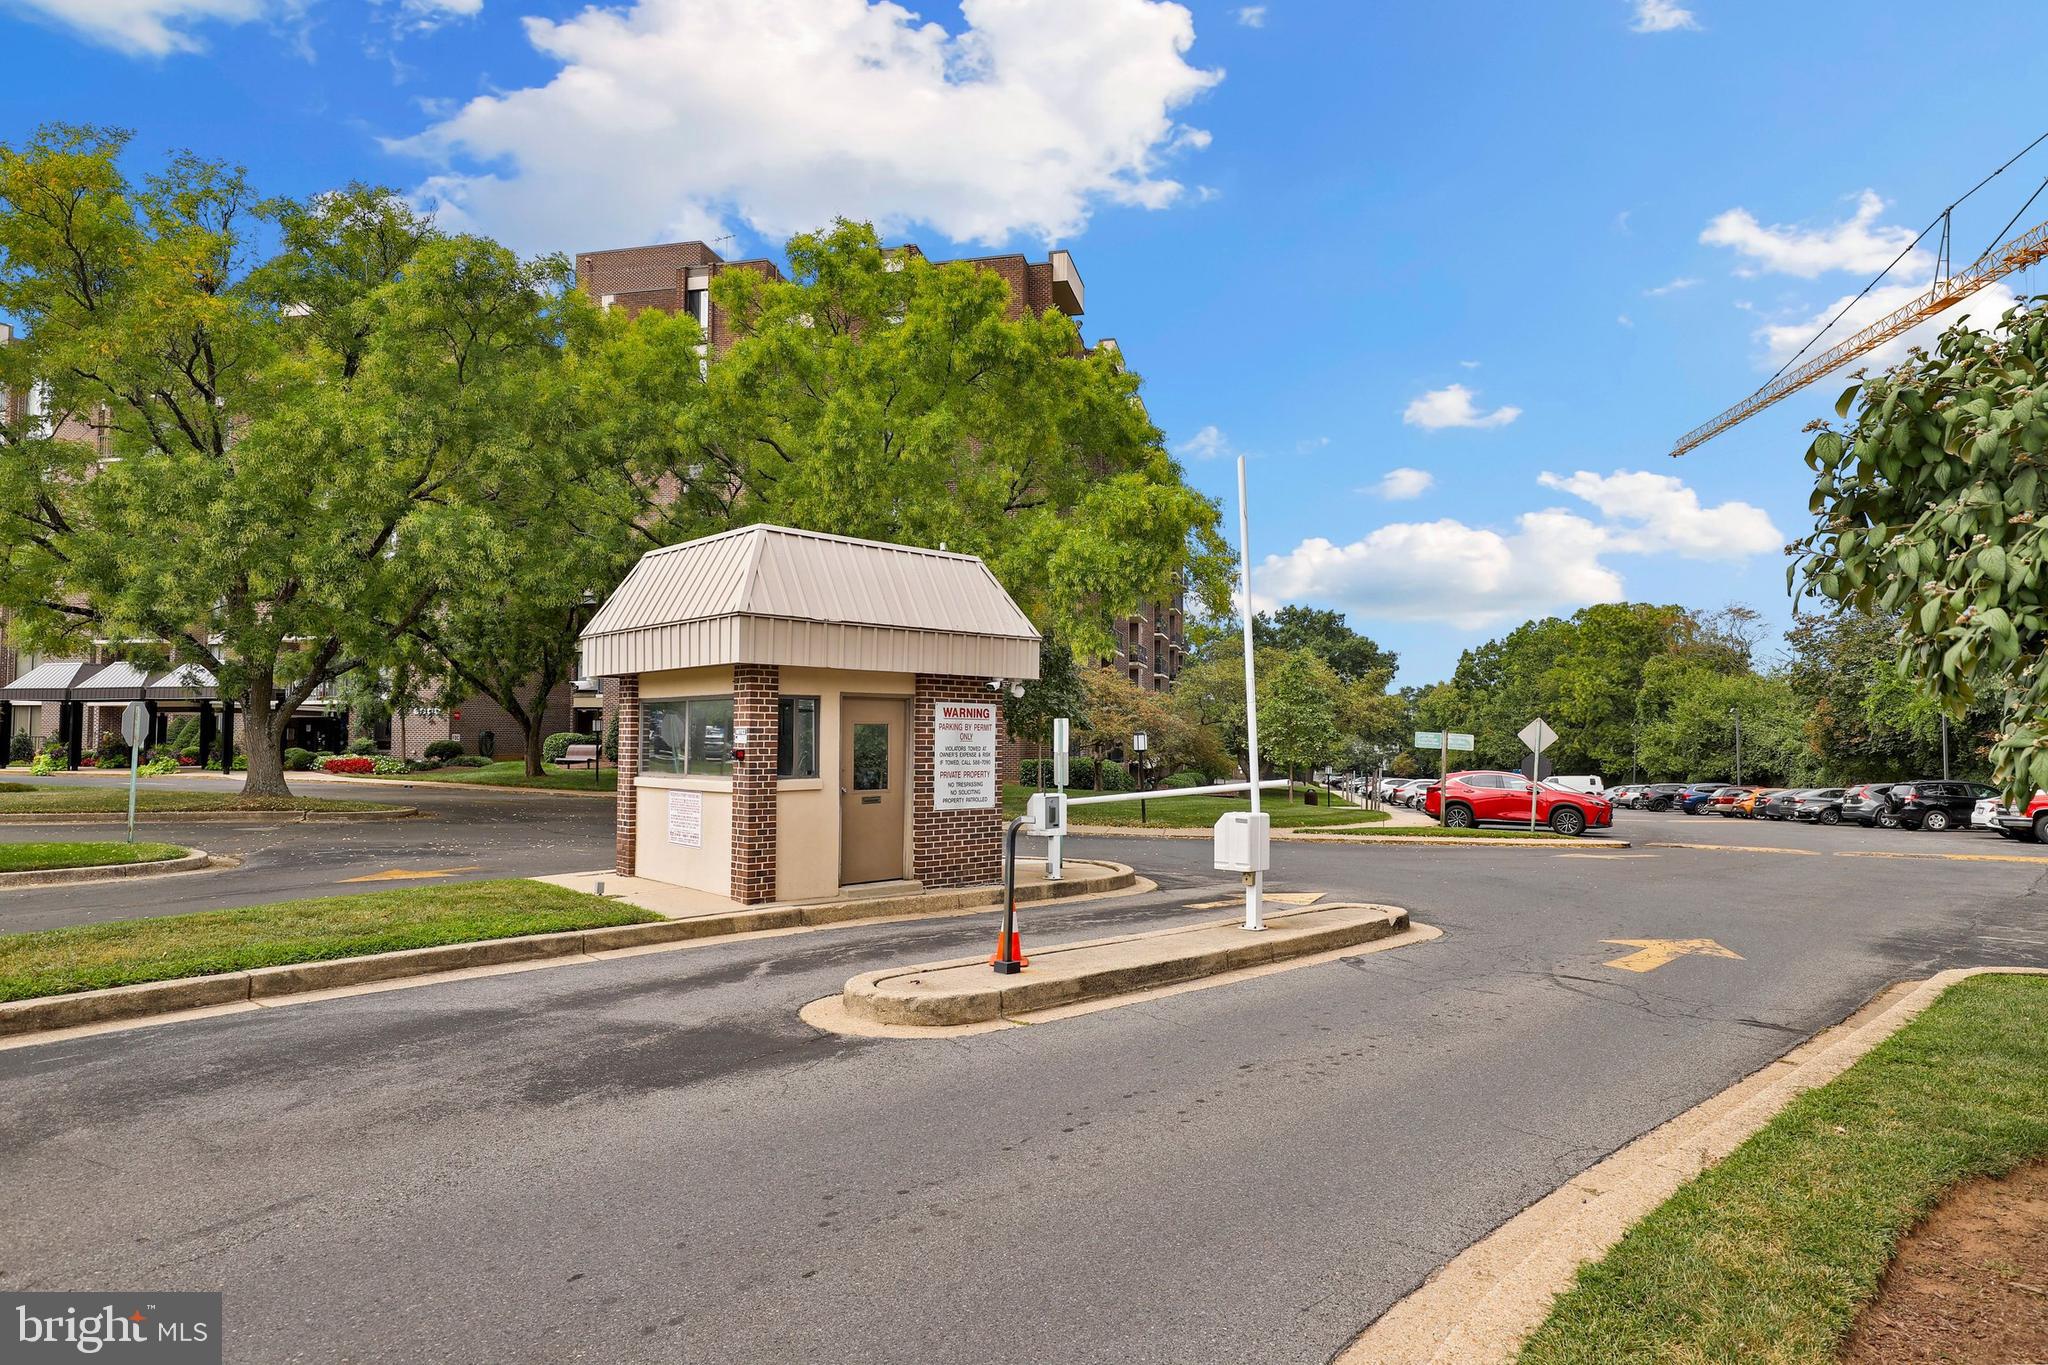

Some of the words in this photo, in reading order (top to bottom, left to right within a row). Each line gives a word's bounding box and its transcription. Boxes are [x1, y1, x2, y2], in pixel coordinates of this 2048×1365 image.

[943, 707, 990, 718] WARNING
[939, 723, 963, 731] PARKING
[964, 723, 972, 731] BY
[974, 723, 992, 731] PERMIT
[963, 770, 990, 778] PROPERTY
